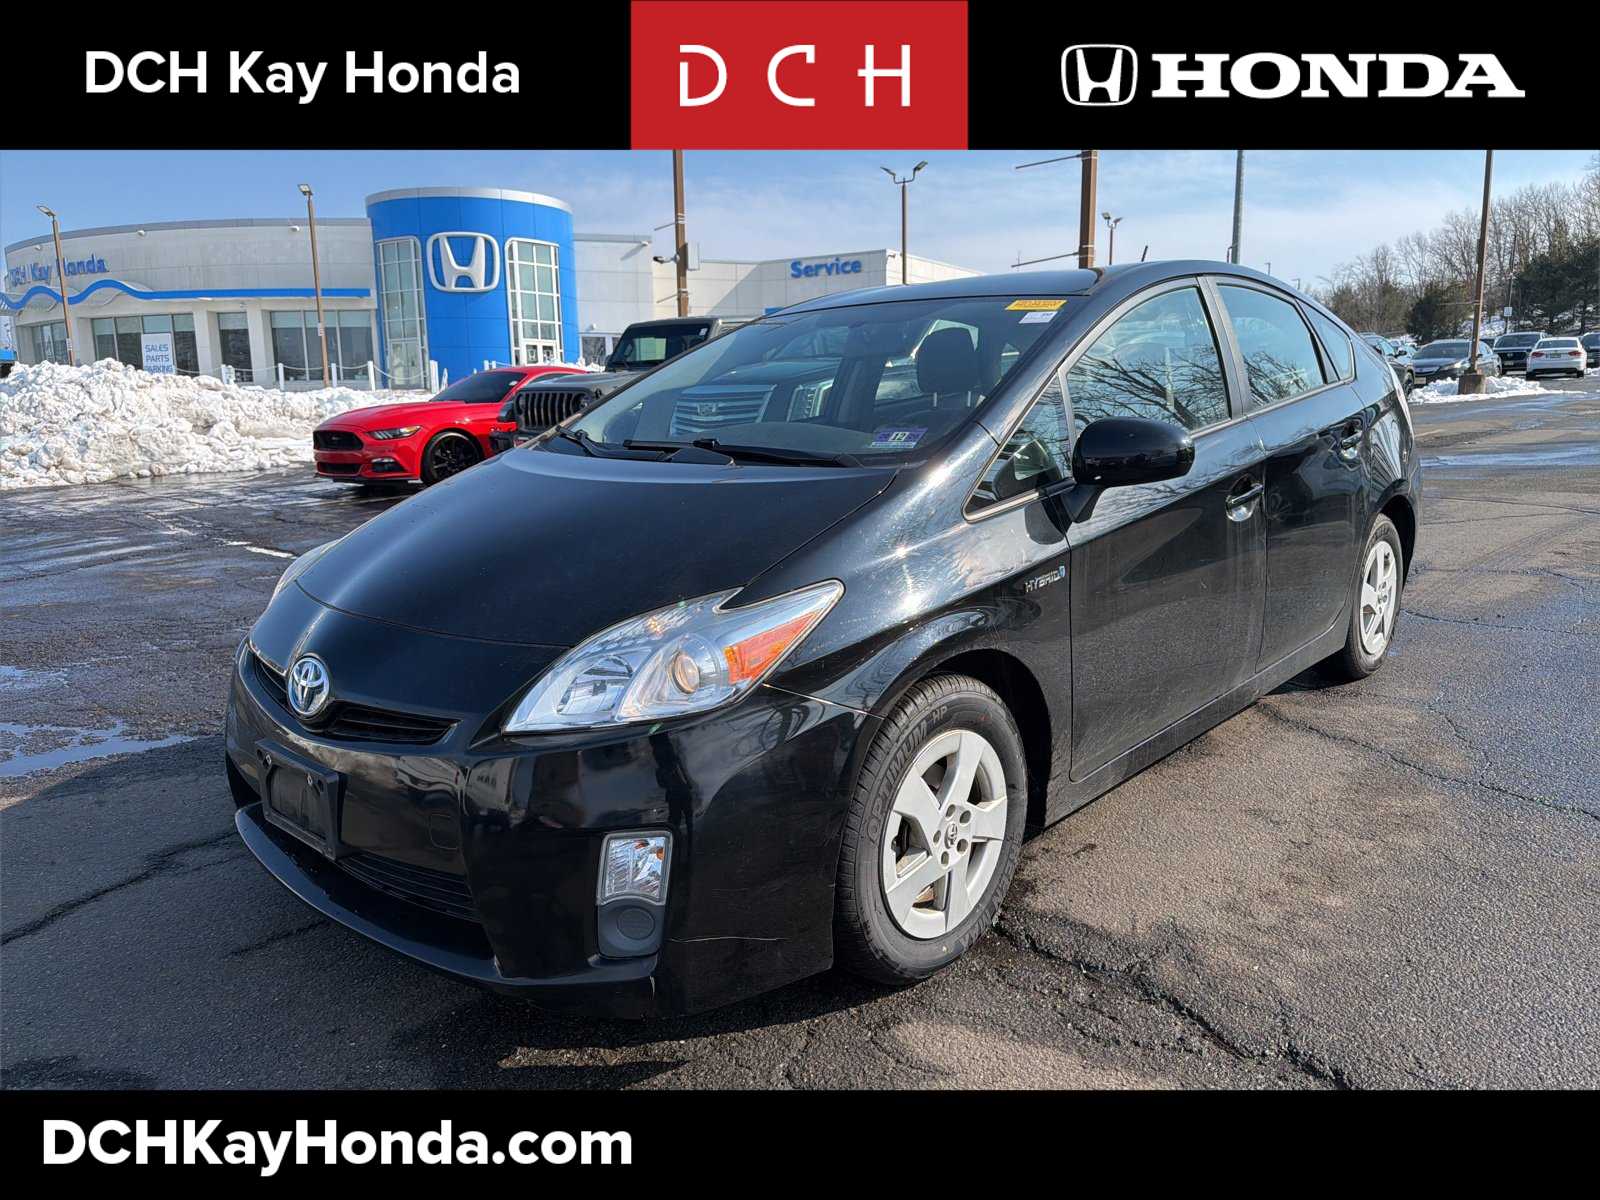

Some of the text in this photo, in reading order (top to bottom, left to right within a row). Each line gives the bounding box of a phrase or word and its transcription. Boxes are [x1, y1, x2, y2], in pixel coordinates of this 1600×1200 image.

[791, 257, 862, 278] Service
[145, 344, 169, 353] SALES
[145, 354, 170, 363] PARTS
[1025, 570, 1061, 593] HYBRID
